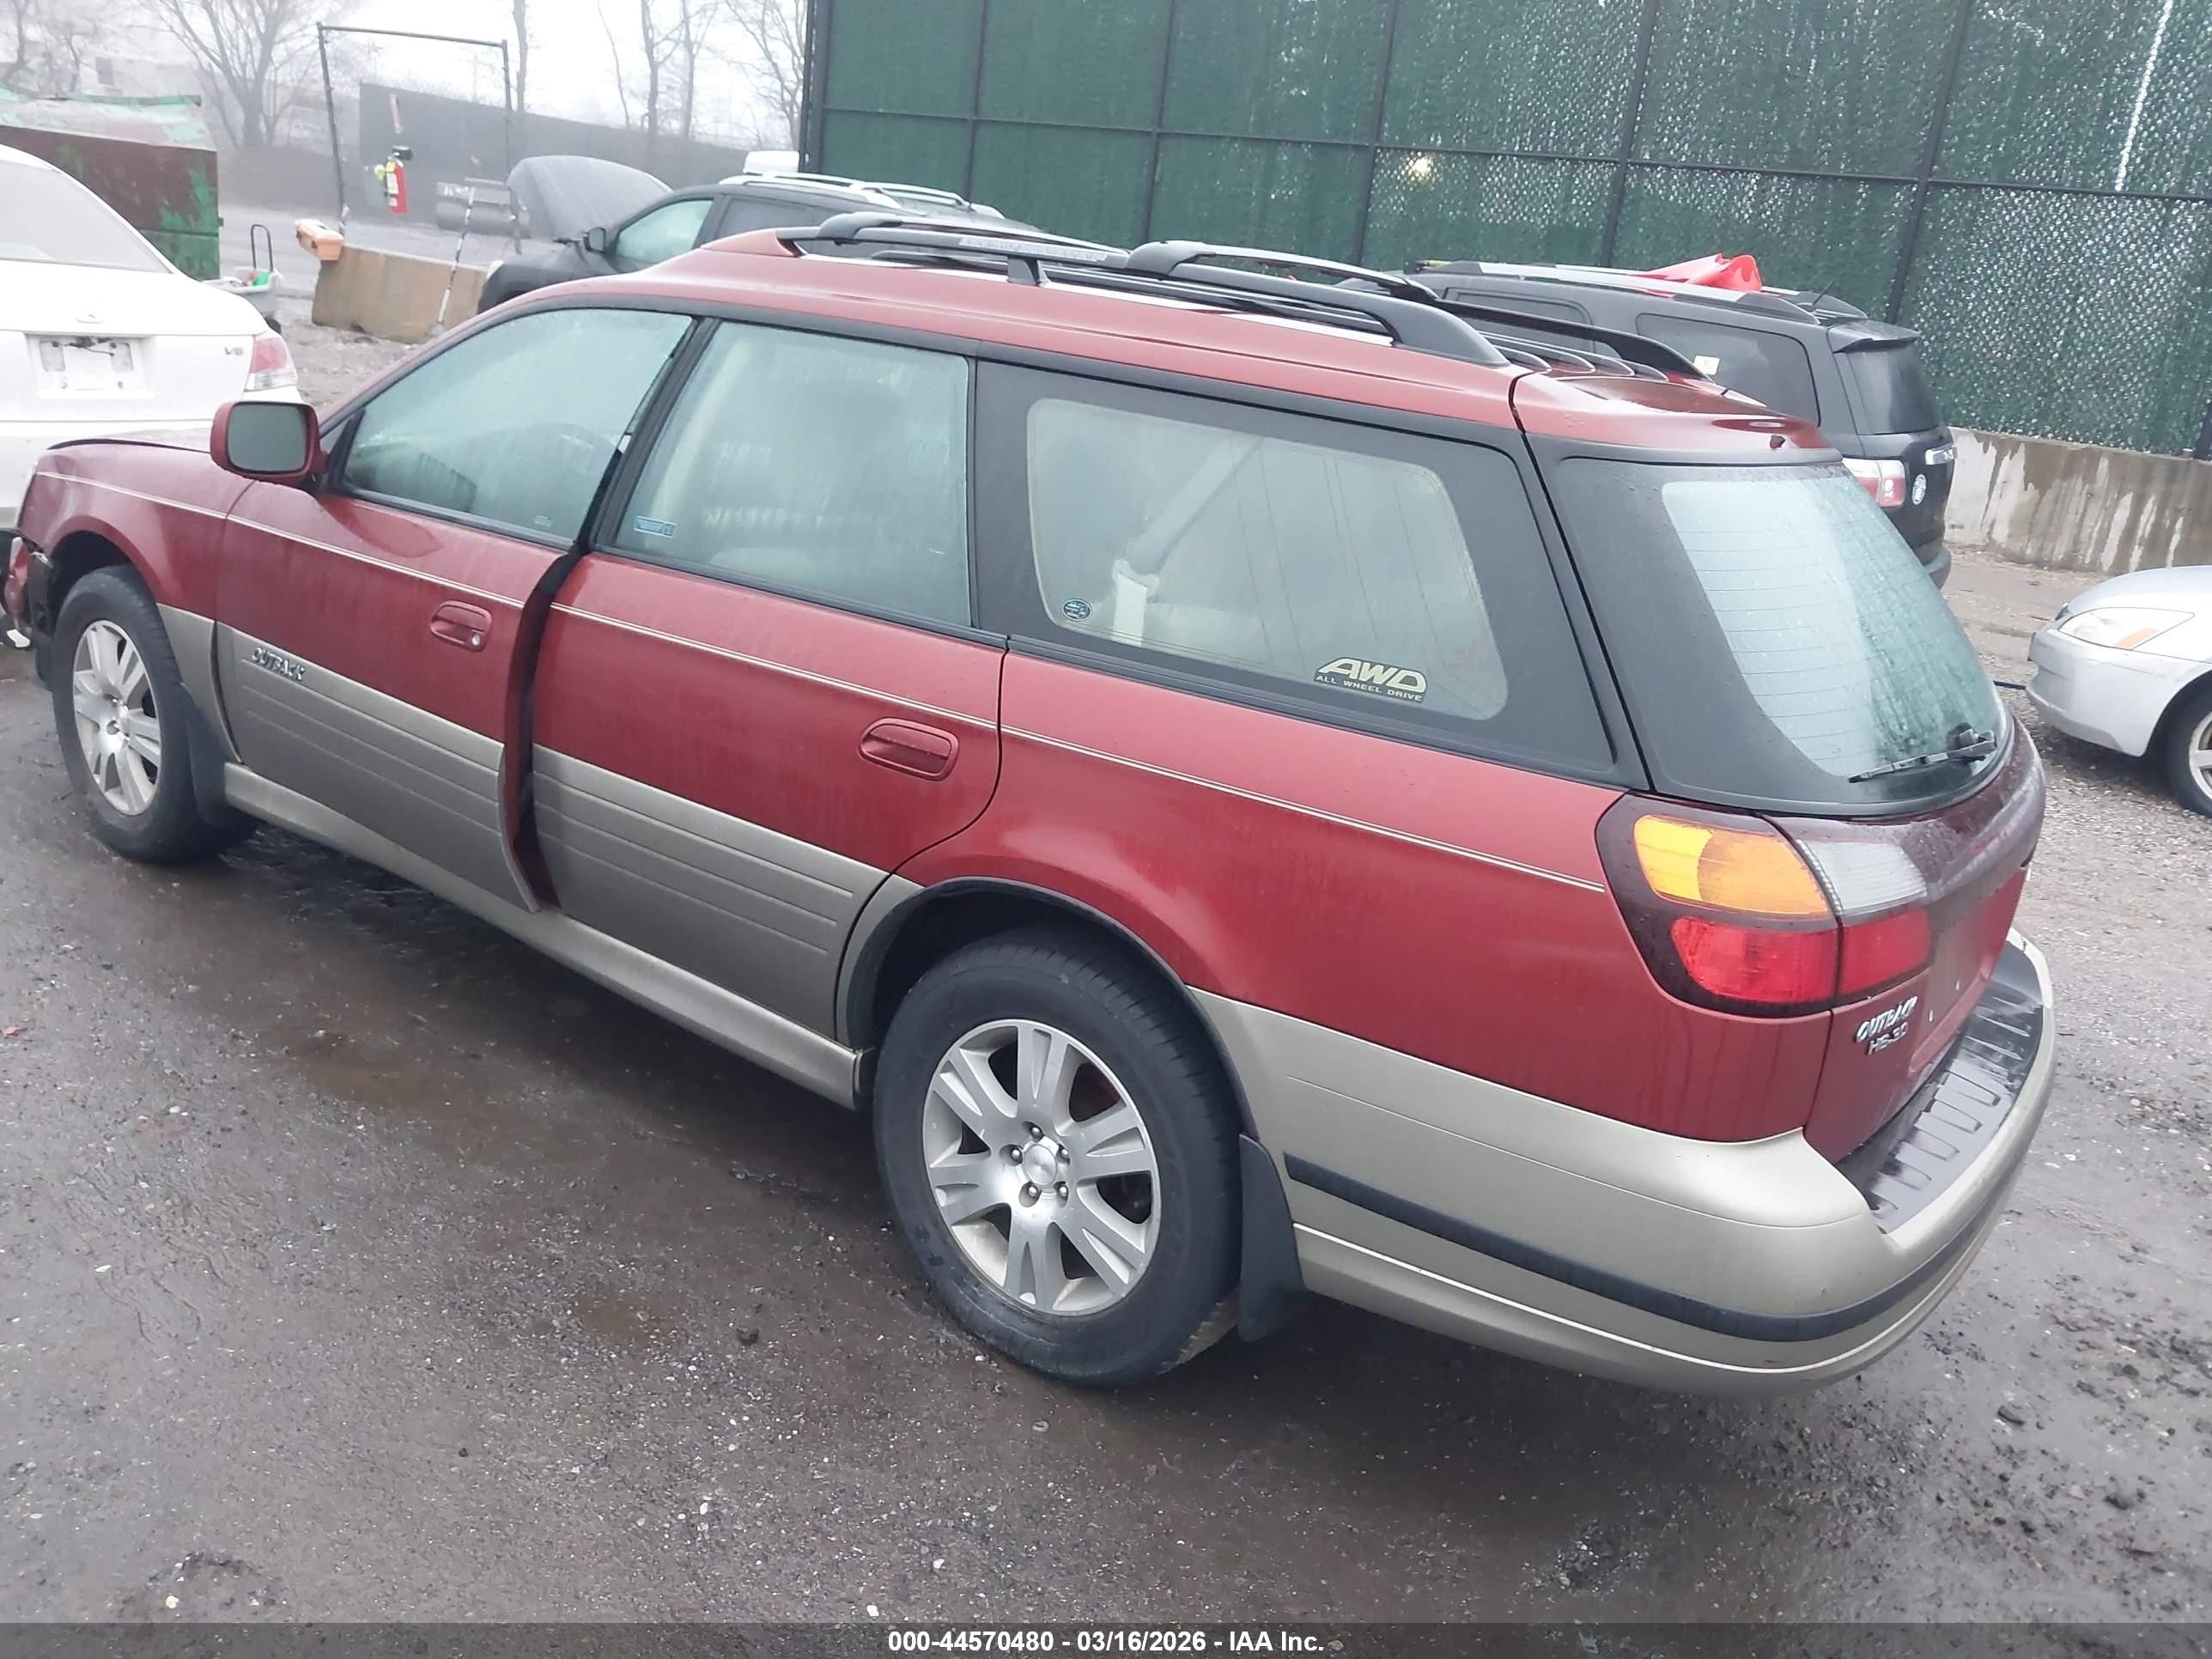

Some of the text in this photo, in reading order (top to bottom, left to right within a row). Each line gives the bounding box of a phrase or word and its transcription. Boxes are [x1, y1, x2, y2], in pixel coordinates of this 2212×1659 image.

[252, 647, 305, 681] OUTBACK
[1316, 658, 1427, 693] AWD
[1316, 675, 1423, 702] ALL WHEEL DRIVE
